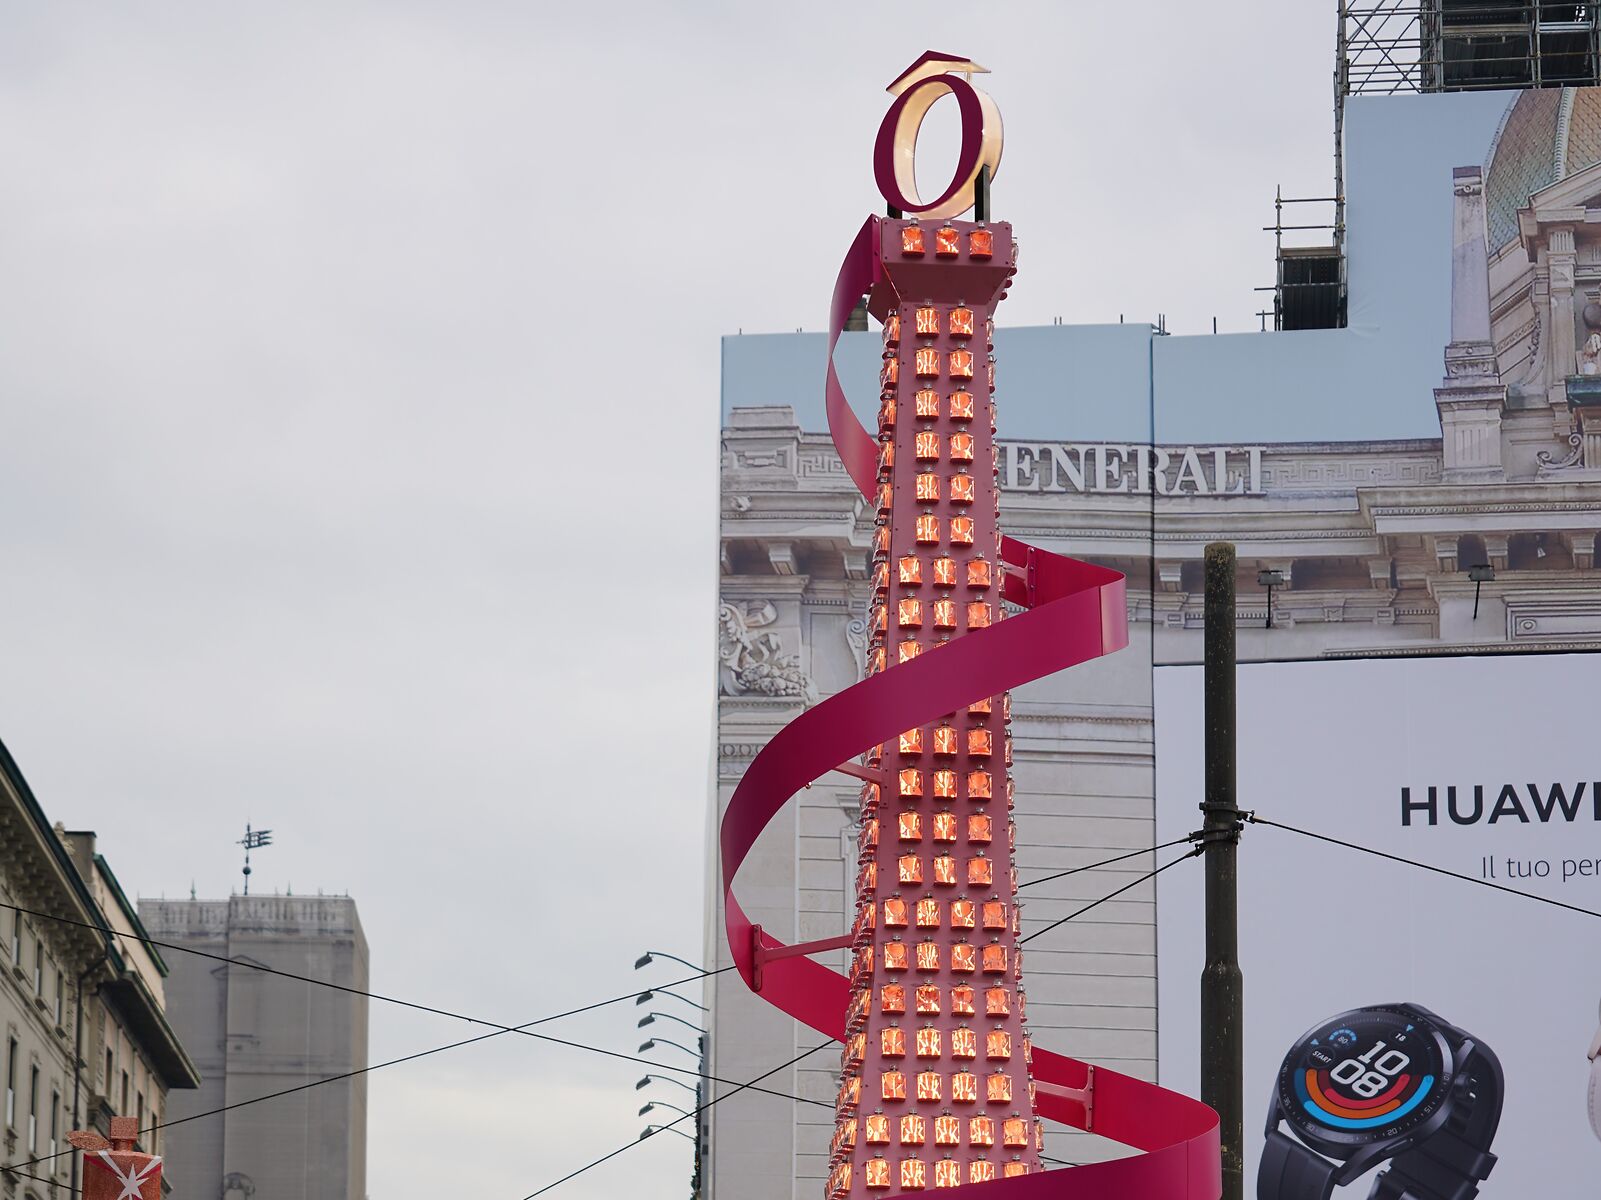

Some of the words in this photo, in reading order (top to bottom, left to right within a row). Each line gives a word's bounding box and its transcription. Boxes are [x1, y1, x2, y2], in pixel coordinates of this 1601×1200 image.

[999, 443, 1267, 495] ENERALI
[1482, 855, 1496, 879] Il
[1506, 857, 1550, 878] tuo
[1312, 1050, 1332, 1063] START
[1357, 1040, 1410, 1076] 10
[1330, 1059, 1389, 1098] 08
